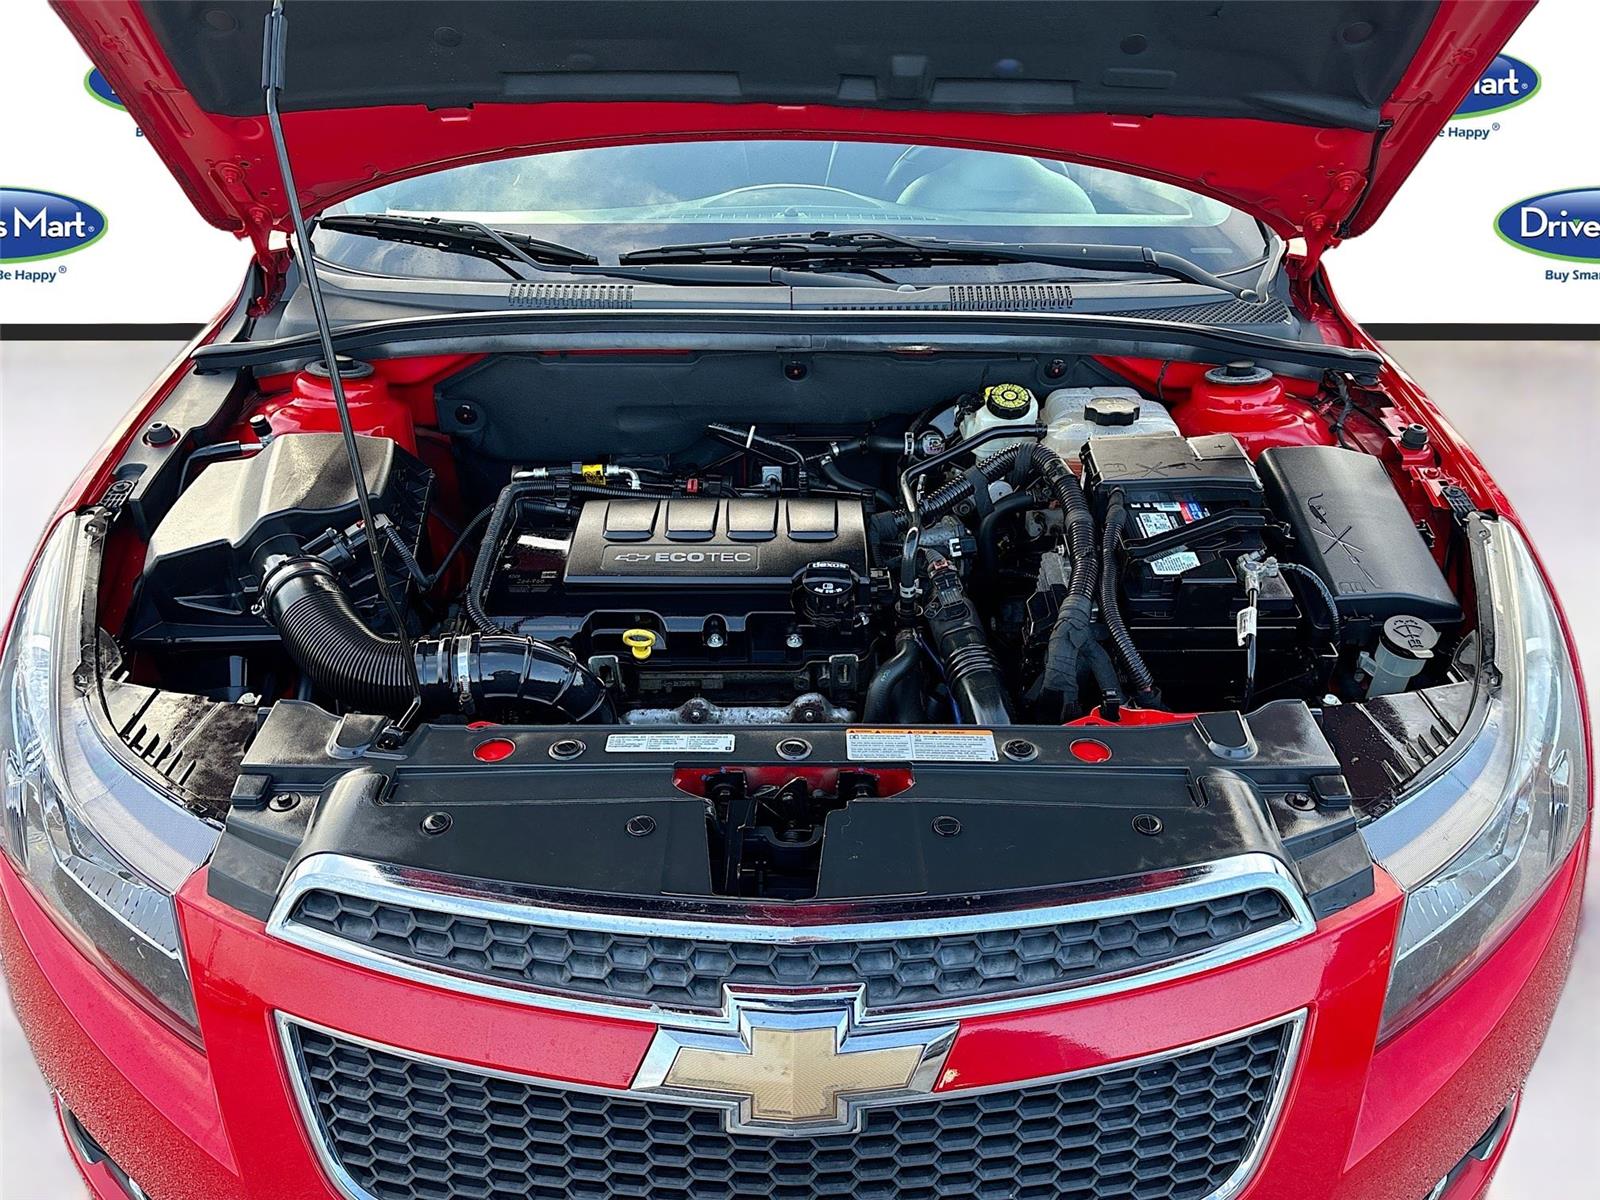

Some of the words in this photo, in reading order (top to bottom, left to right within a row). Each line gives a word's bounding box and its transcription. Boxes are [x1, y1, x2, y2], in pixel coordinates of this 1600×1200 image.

[1448, 127, 1490, 140] Happy
[14, 206, 86, 237] Mart
[15, 270, 57, 283] Happy
[1545, 270, 1570, 283] Buy
[1572, 270, 1600, 280] Sma
[655, 552, 751, 562] ECOTEC
